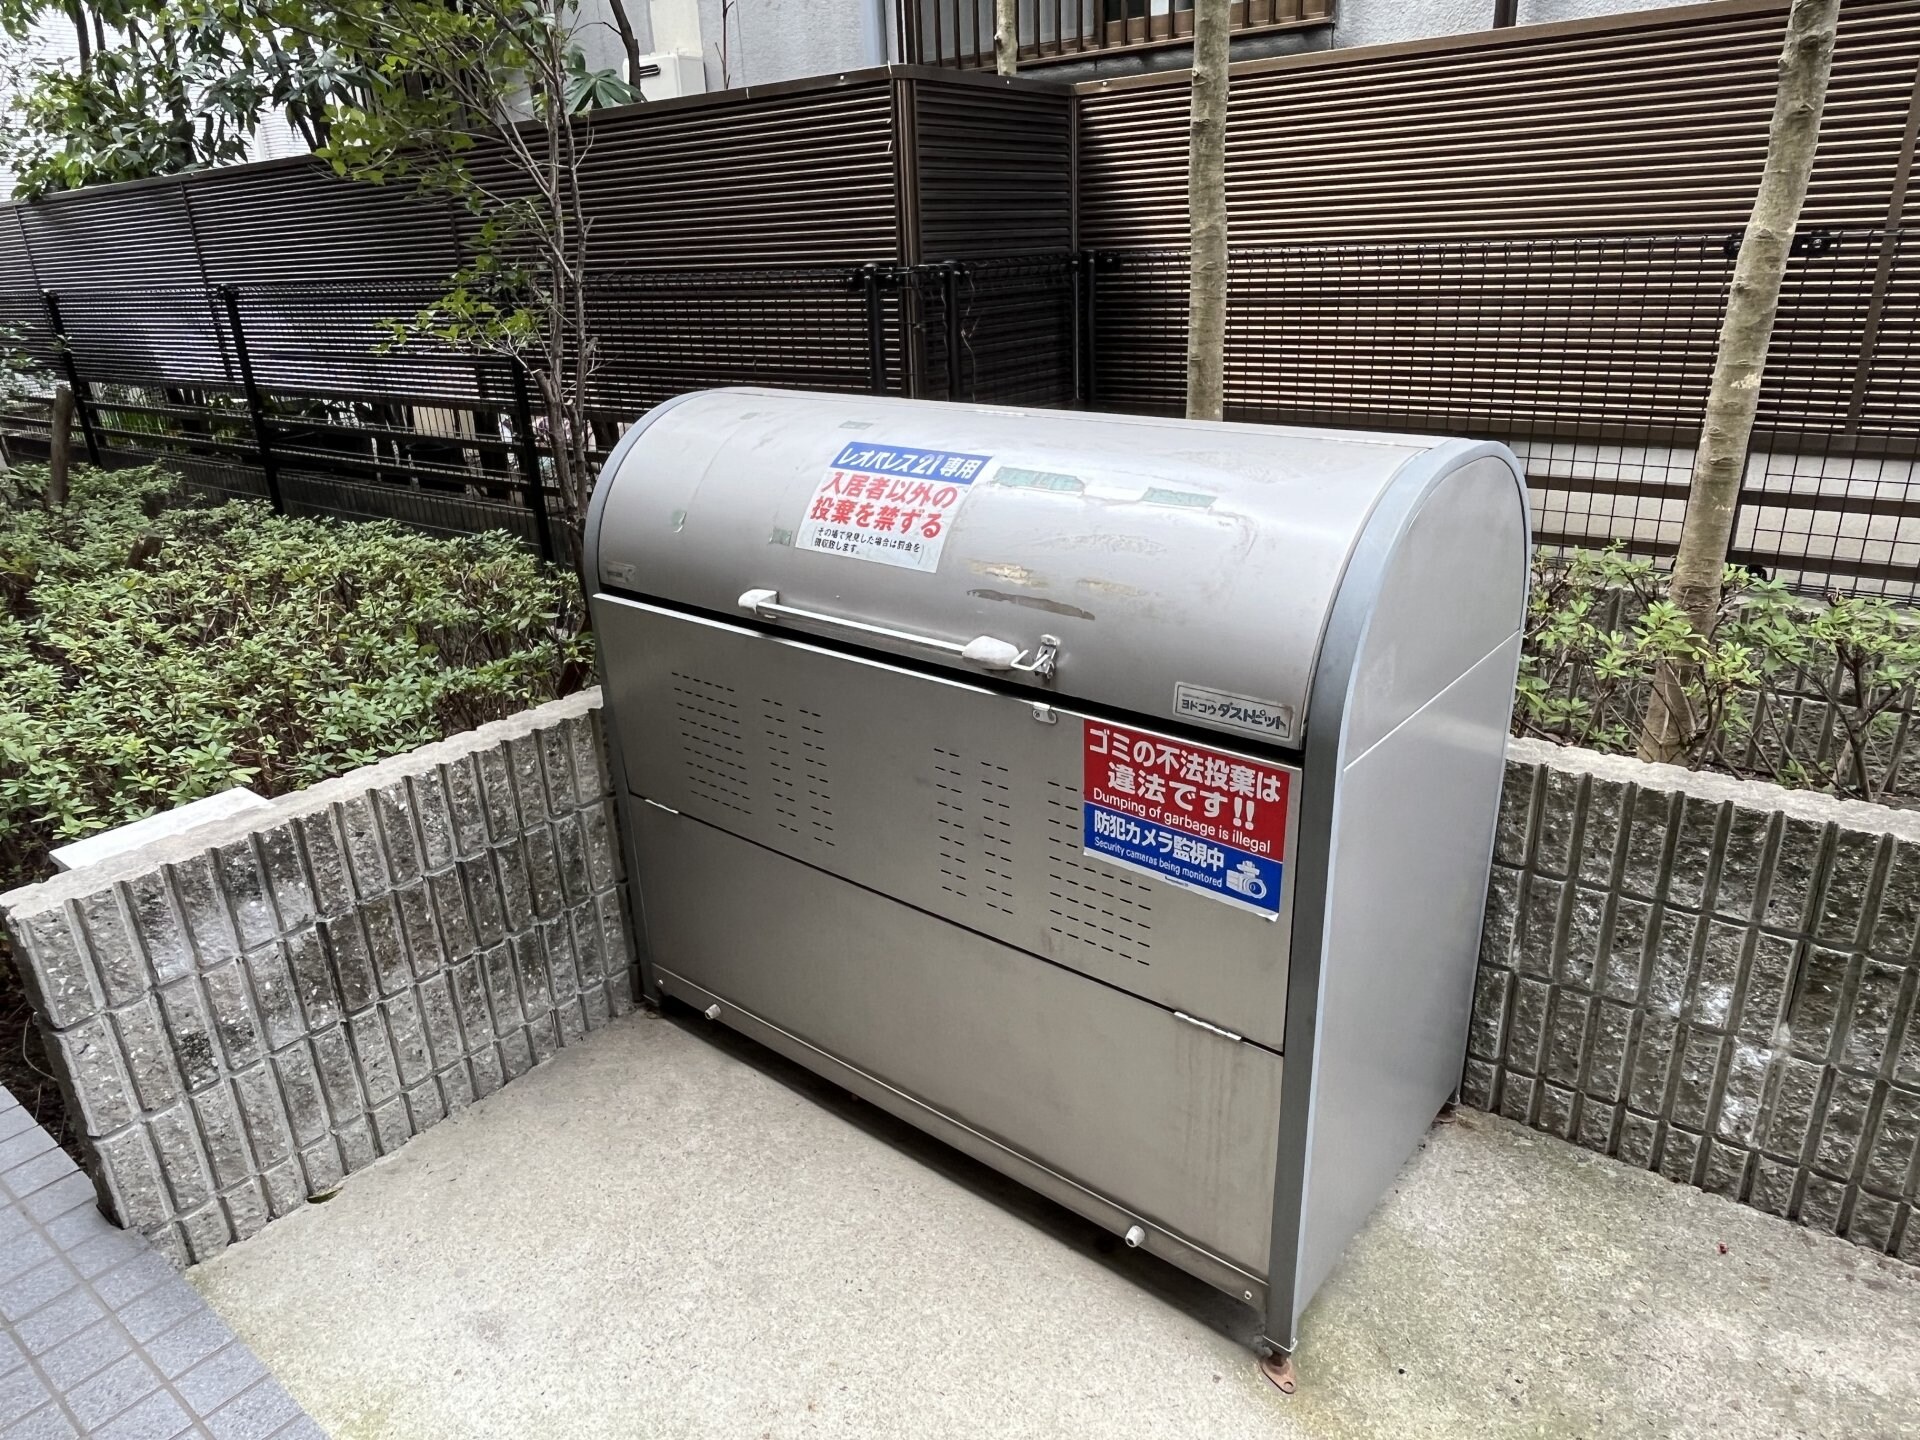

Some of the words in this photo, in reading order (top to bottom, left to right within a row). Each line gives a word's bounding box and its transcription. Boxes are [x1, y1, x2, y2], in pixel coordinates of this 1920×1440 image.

[810, 495, 942, 538] 投棄を禁ずる
[821, 471, 958, 508] 入居者以外の
[1089, 727, 1281, 802] ゴミの不法投棄は
[1093, 788, 1146, 816] Dumping
[1149, 806, 1162, 819] of
[1164, 811, 1216, 837] garbage
[1218, 825, 1229, 840] is
[1232, 829, 1271, 854] illegal
[1094, 809, 1225, 872] 防犯カメラ監視中
[1094, 836, 1125, 857] Security
[1126, 846, 1158, 866] cameras
[1158, 857, 1181, 875] being
[1182, 867, 1222, 888] monitored
